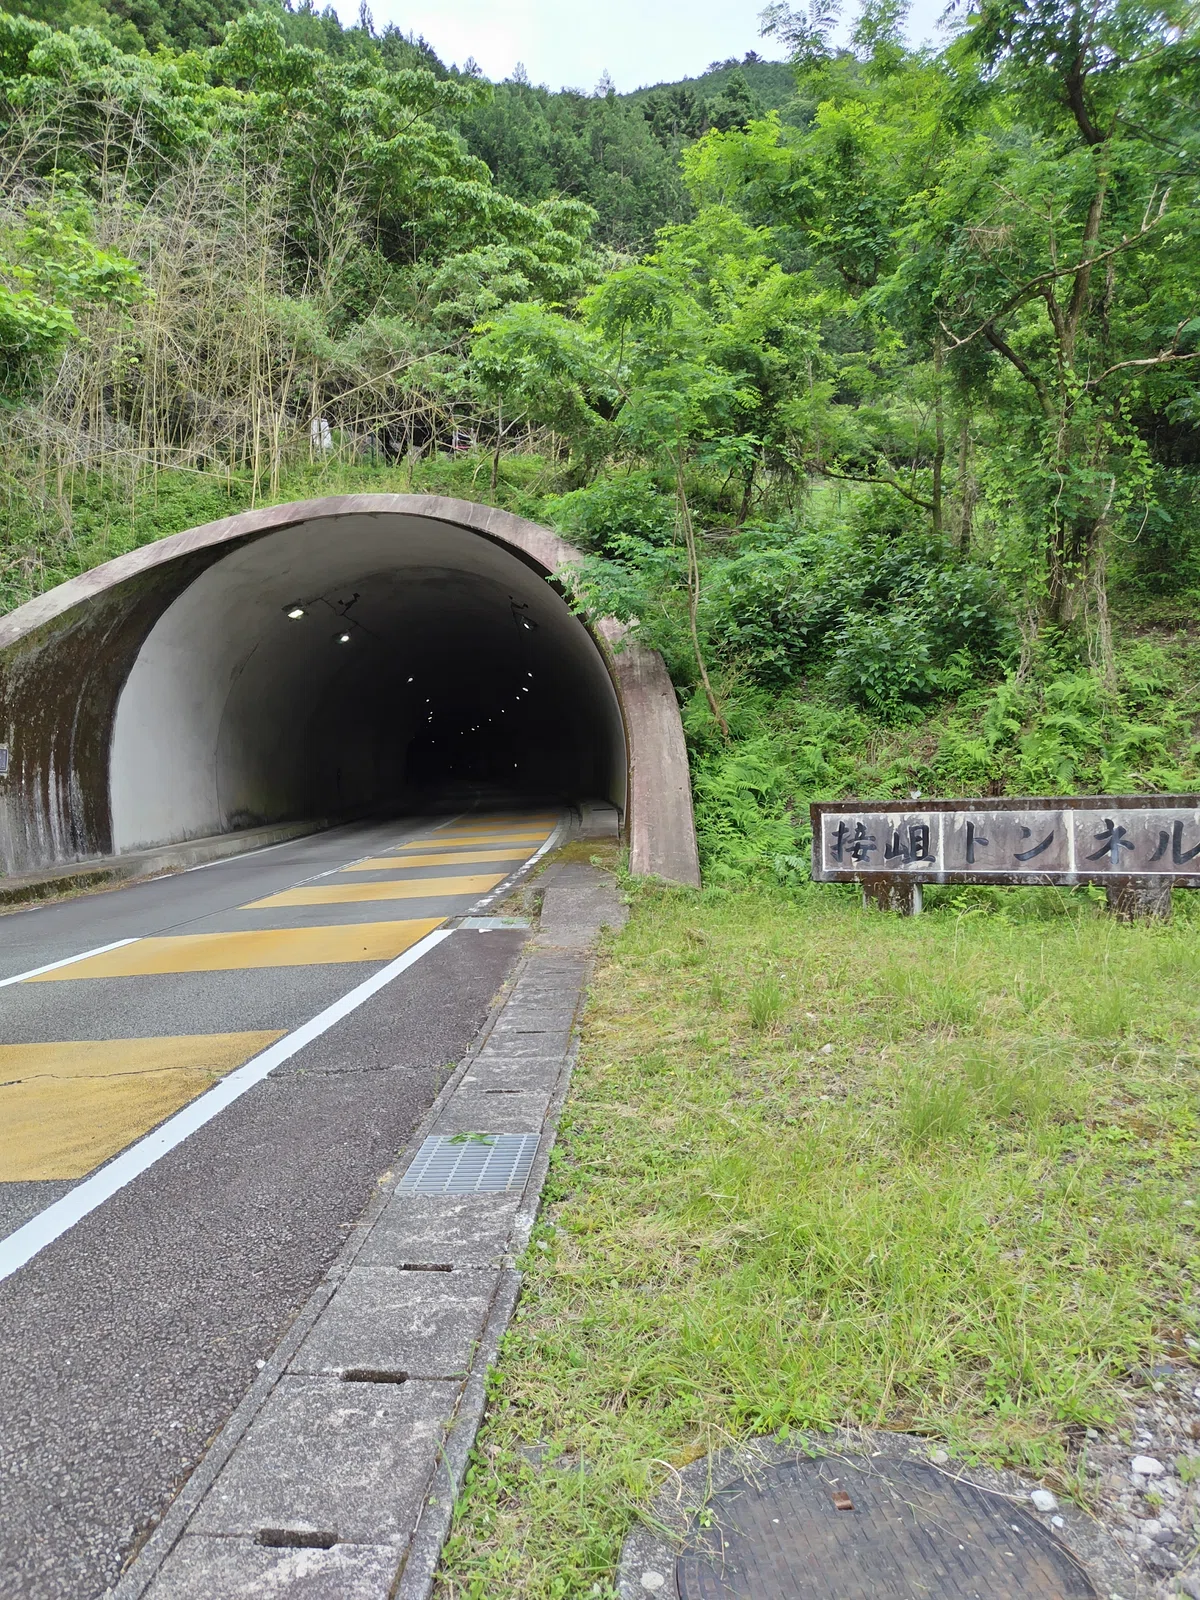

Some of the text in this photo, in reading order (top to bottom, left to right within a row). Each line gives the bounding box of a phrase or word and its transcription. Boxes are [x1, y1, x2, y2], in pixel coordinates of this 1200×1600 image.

[830, 818, 1200, 865] 接岨トンネル
